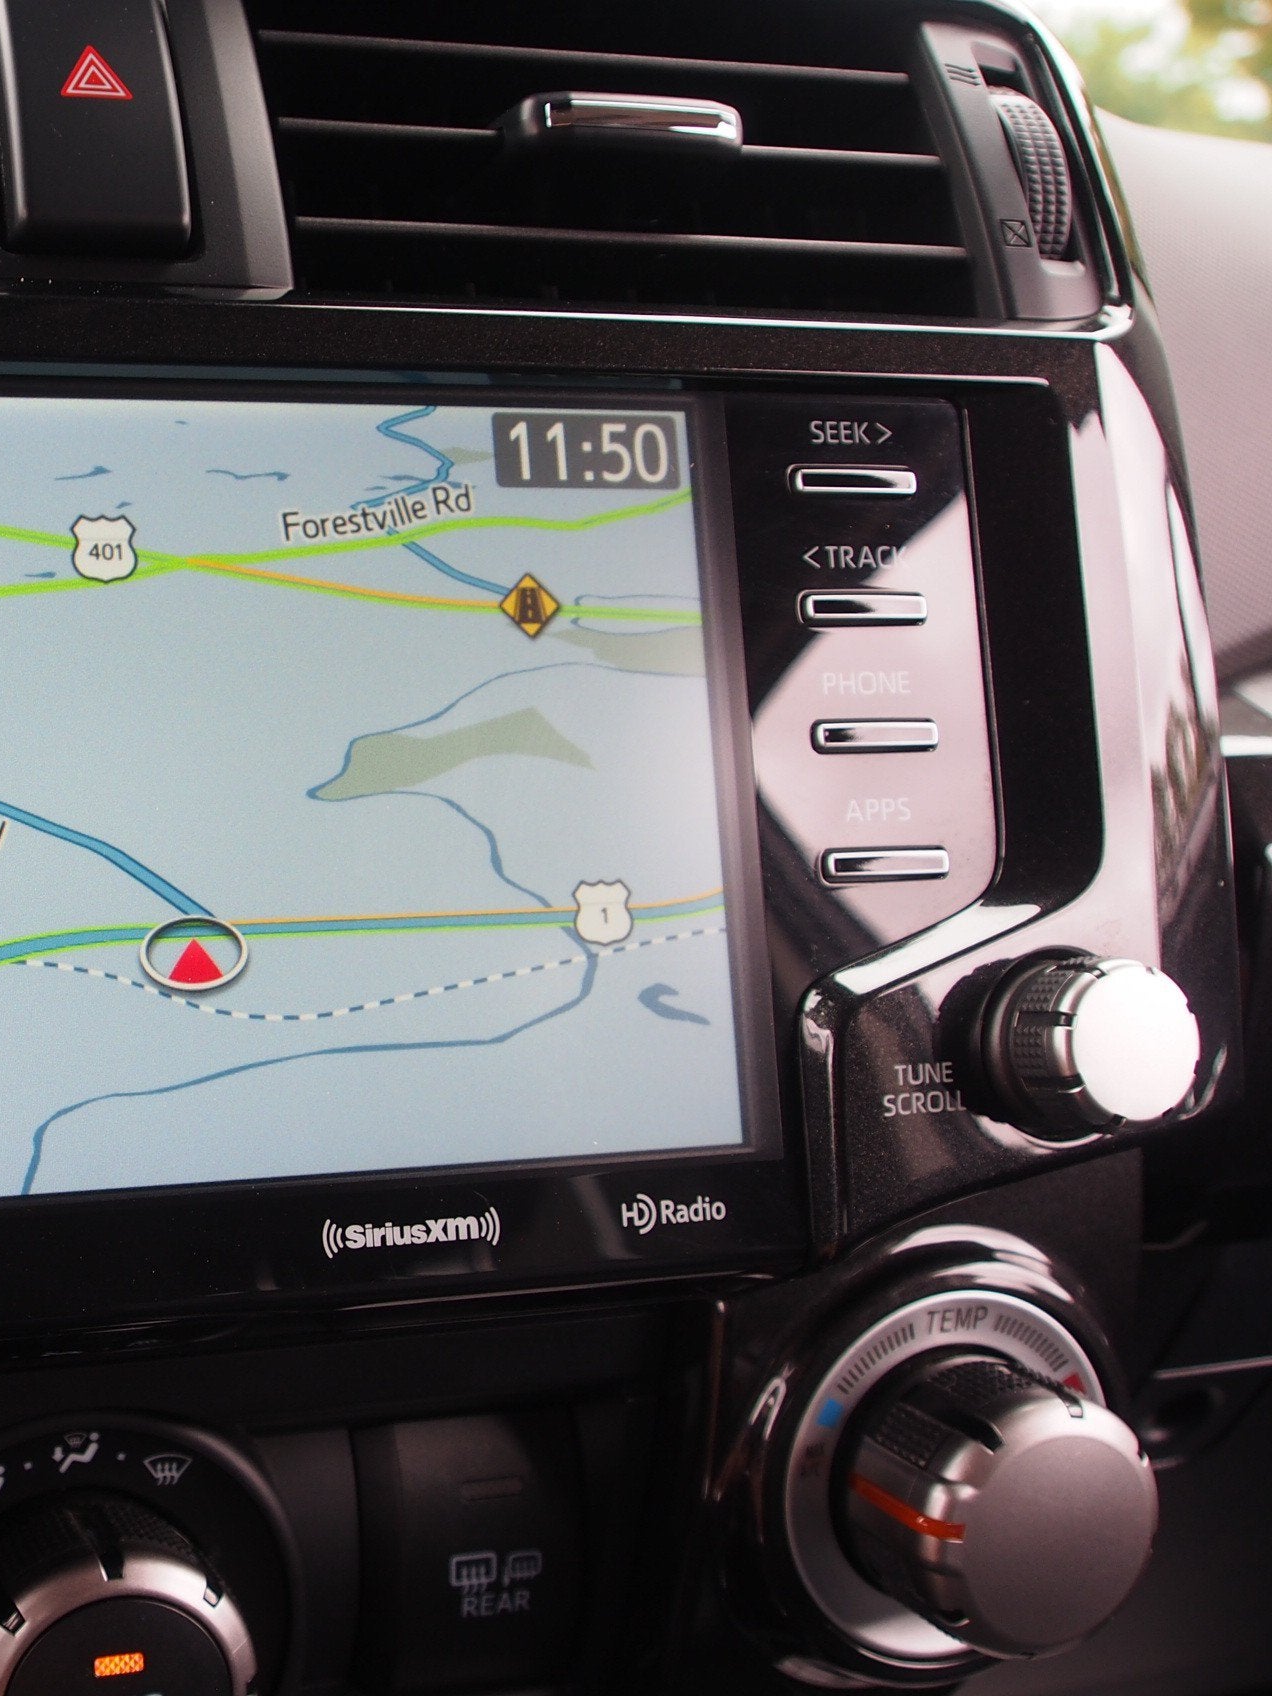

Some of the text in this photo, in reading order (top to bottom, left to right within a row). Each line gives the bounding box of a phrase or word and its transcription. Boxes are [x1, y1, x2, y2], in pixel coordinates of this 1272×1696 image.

[506, 419, 670, 485] 11:50
[281, 483, 474, 542] Forestville Rd
[87, 541, 124, 563] 401
[822, 670, 912, 696] PHONE
[845, 797, 912, 823] APPS
[894, 1061, 954, 1086] TUNE
[883, 1090, 967, 1117] SCROLL
[660, 1195, 727, 1225] Radio
[926, 1305, 989, 1336] TEMP
[461, 1590, 531, 1618] REAR
